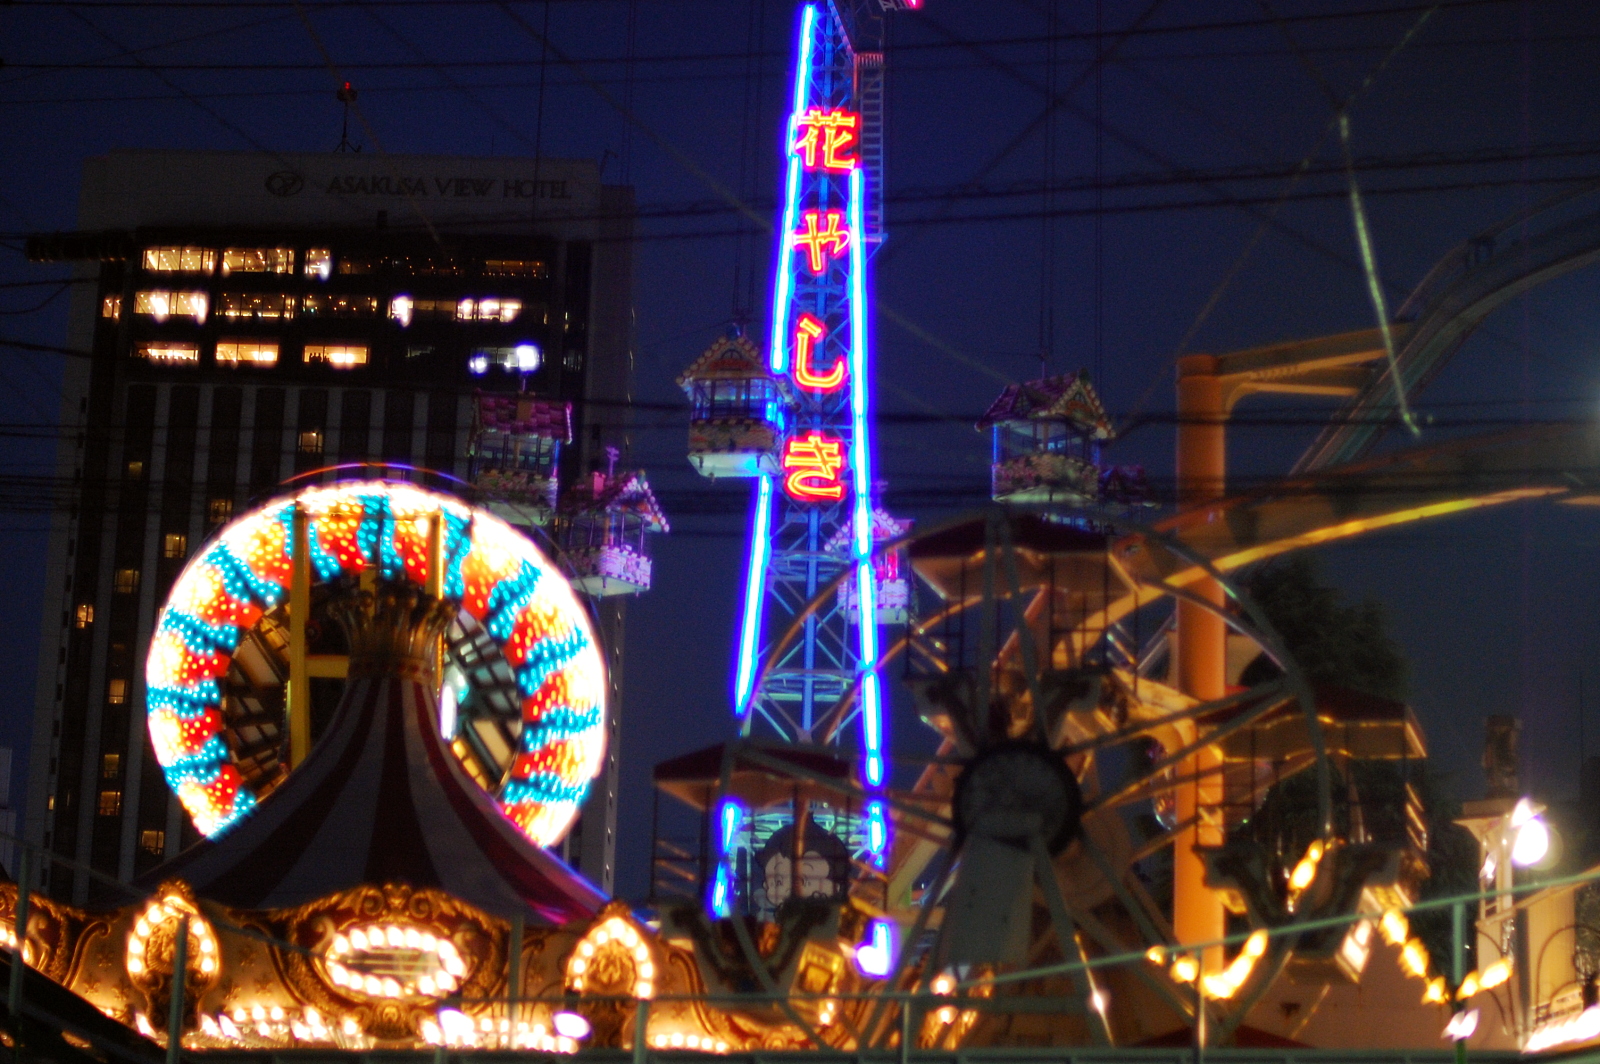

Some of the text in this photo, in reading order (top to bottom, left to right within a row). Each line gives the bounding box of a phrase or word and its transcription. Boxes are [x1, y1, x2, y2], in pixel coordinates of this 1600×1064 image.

[326, 176, 572, 199] ASAKUSA VIEW HOTEL
[784, 109, 859, 502] 花やしき
